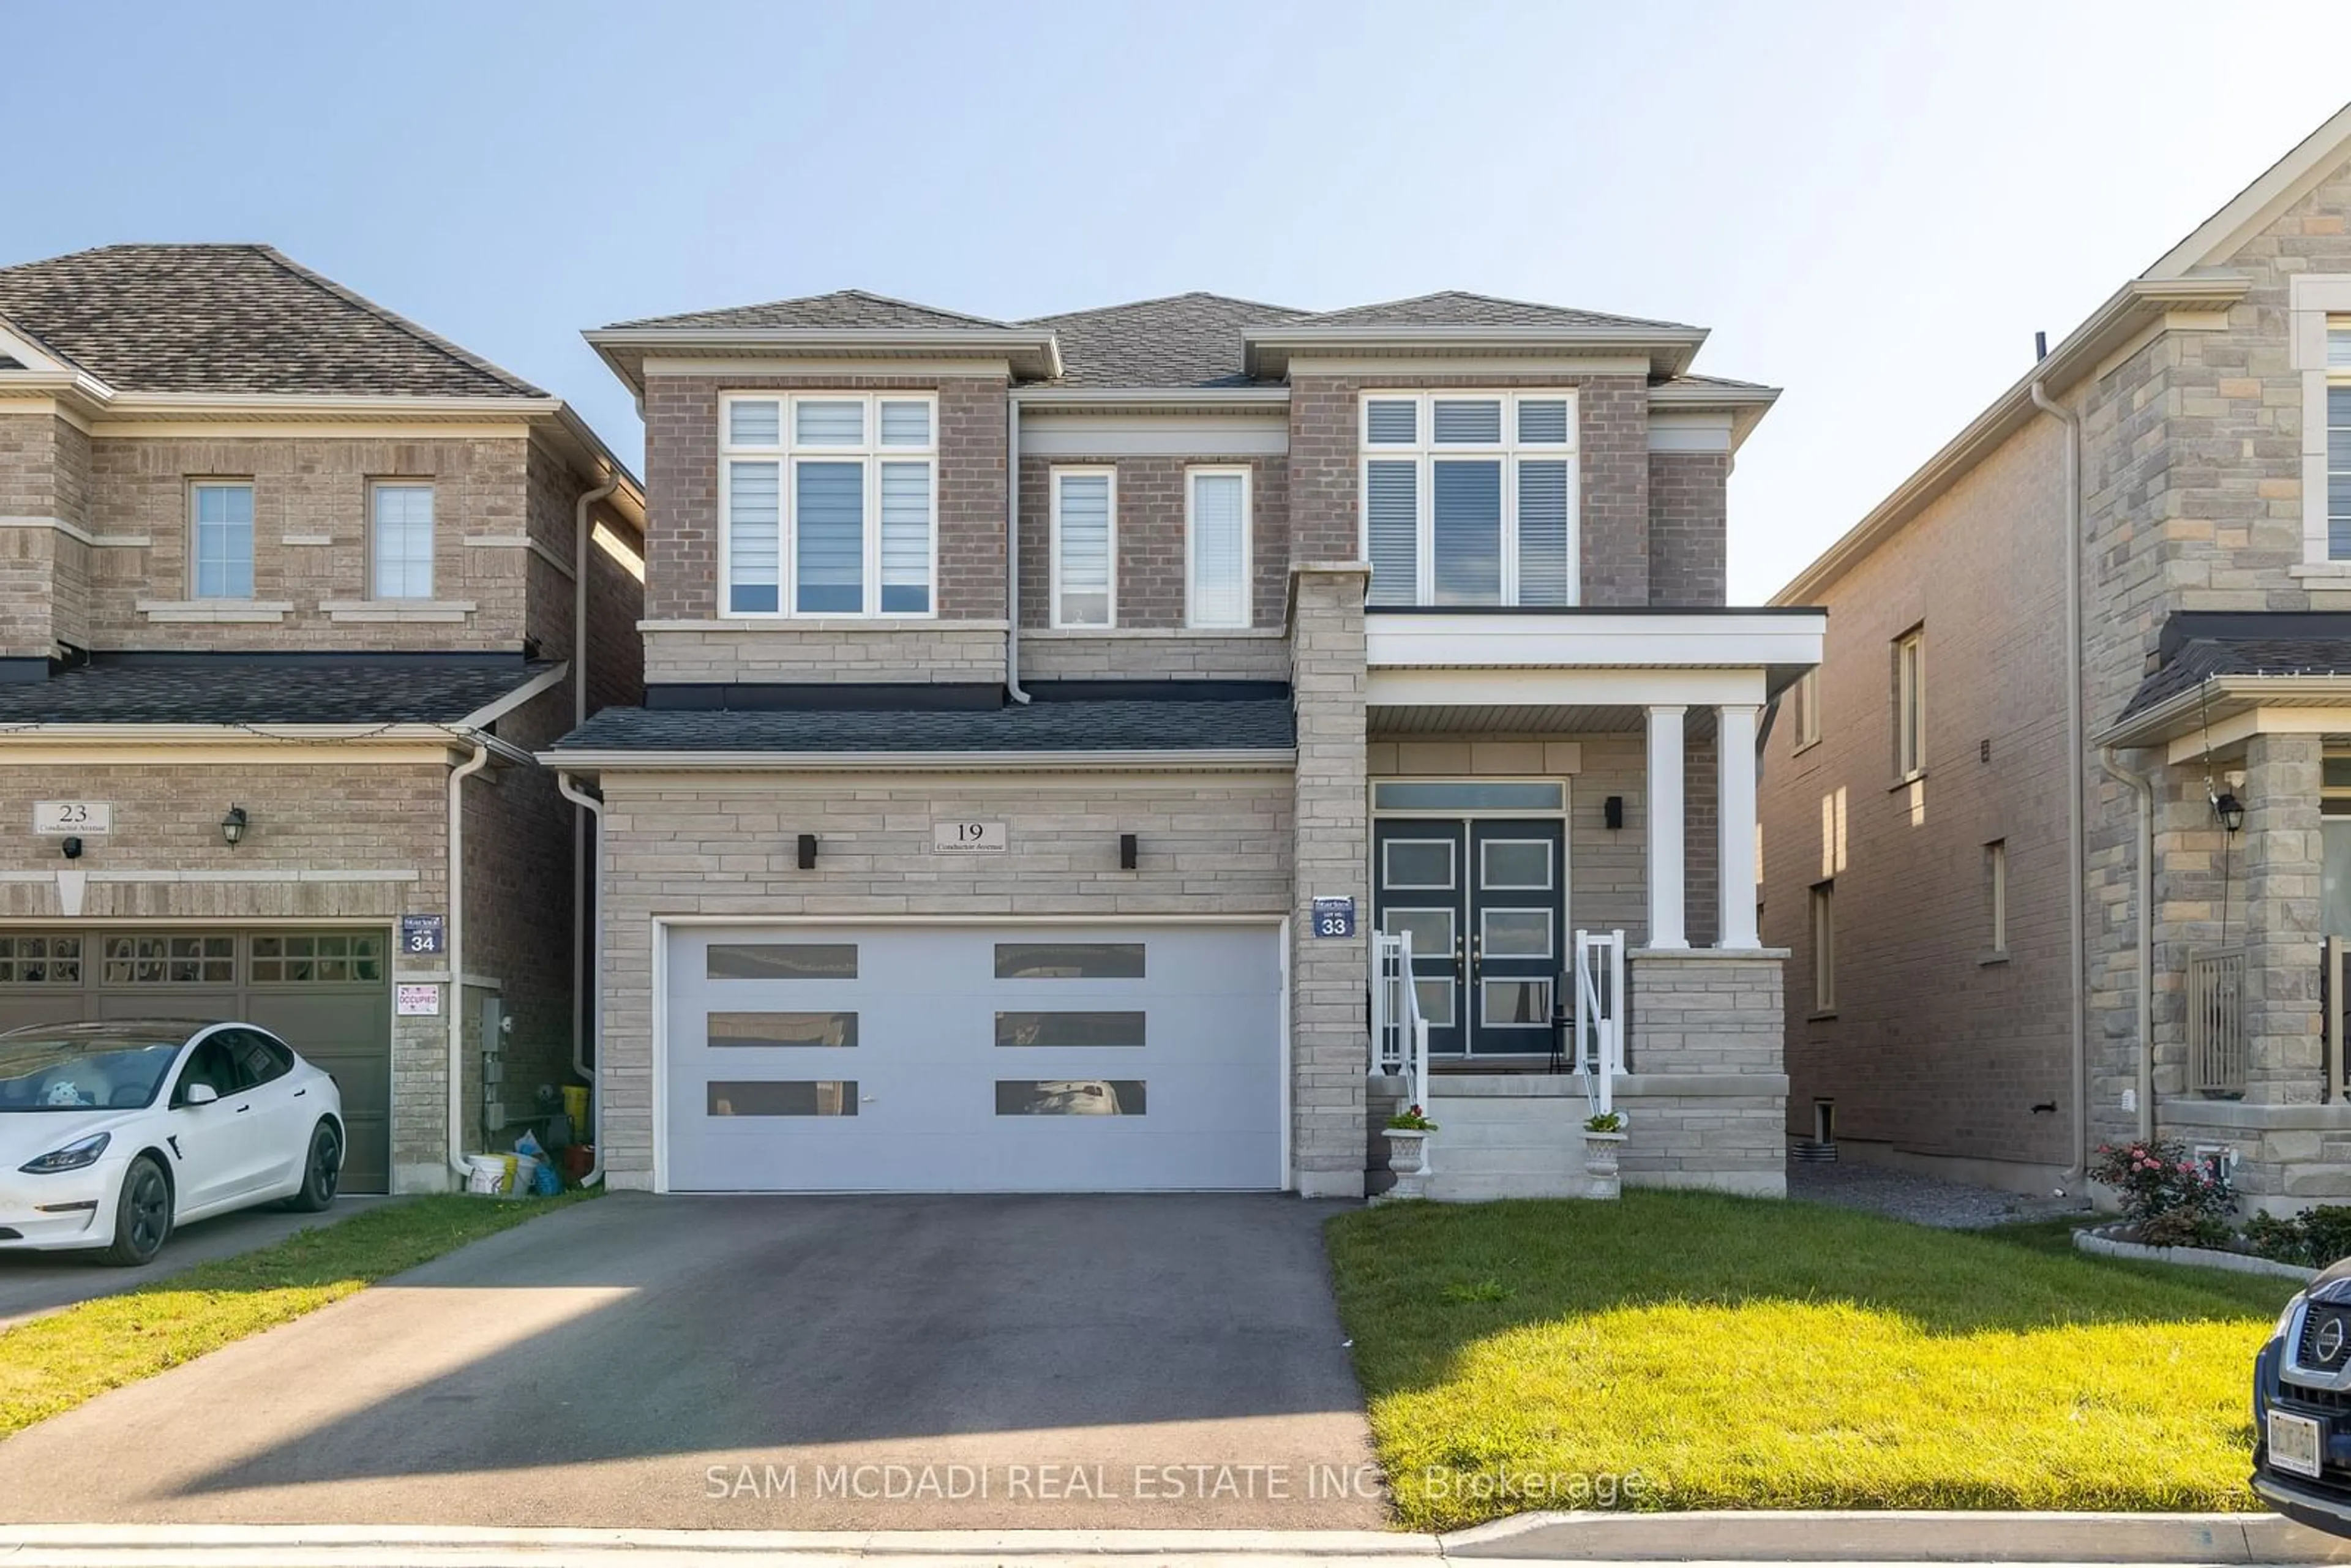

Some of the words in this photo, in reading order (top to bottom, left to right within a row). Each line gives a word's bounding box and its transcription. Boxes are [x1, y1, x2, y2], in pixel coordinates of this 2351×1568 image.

[59, 805, 86, 822] 23
[958, 823, 983, 841] 19
[1322, 918, 1346, 935] 33
[411, 936, 435, 951] 34
